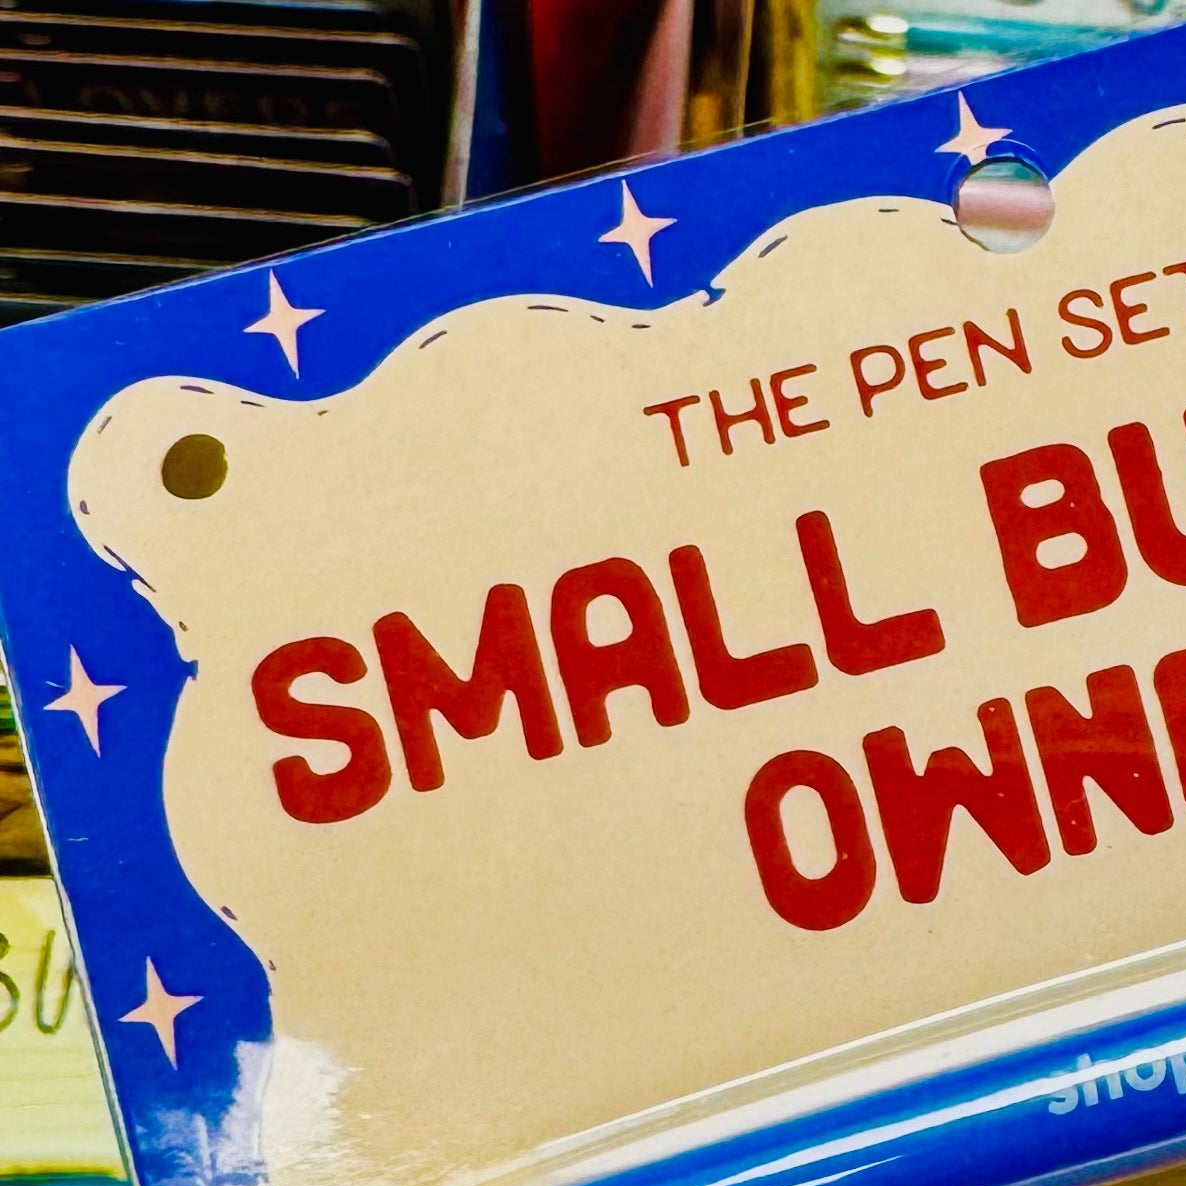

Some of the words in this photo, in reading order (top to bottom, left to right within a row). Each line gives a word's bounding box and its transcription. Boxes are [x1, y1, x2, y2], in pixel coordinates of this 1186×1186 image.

[643, 364, 830, 467] THE
[851, 309, 1032, 418] PEN
[252, 511, 945, 824] SMALL
